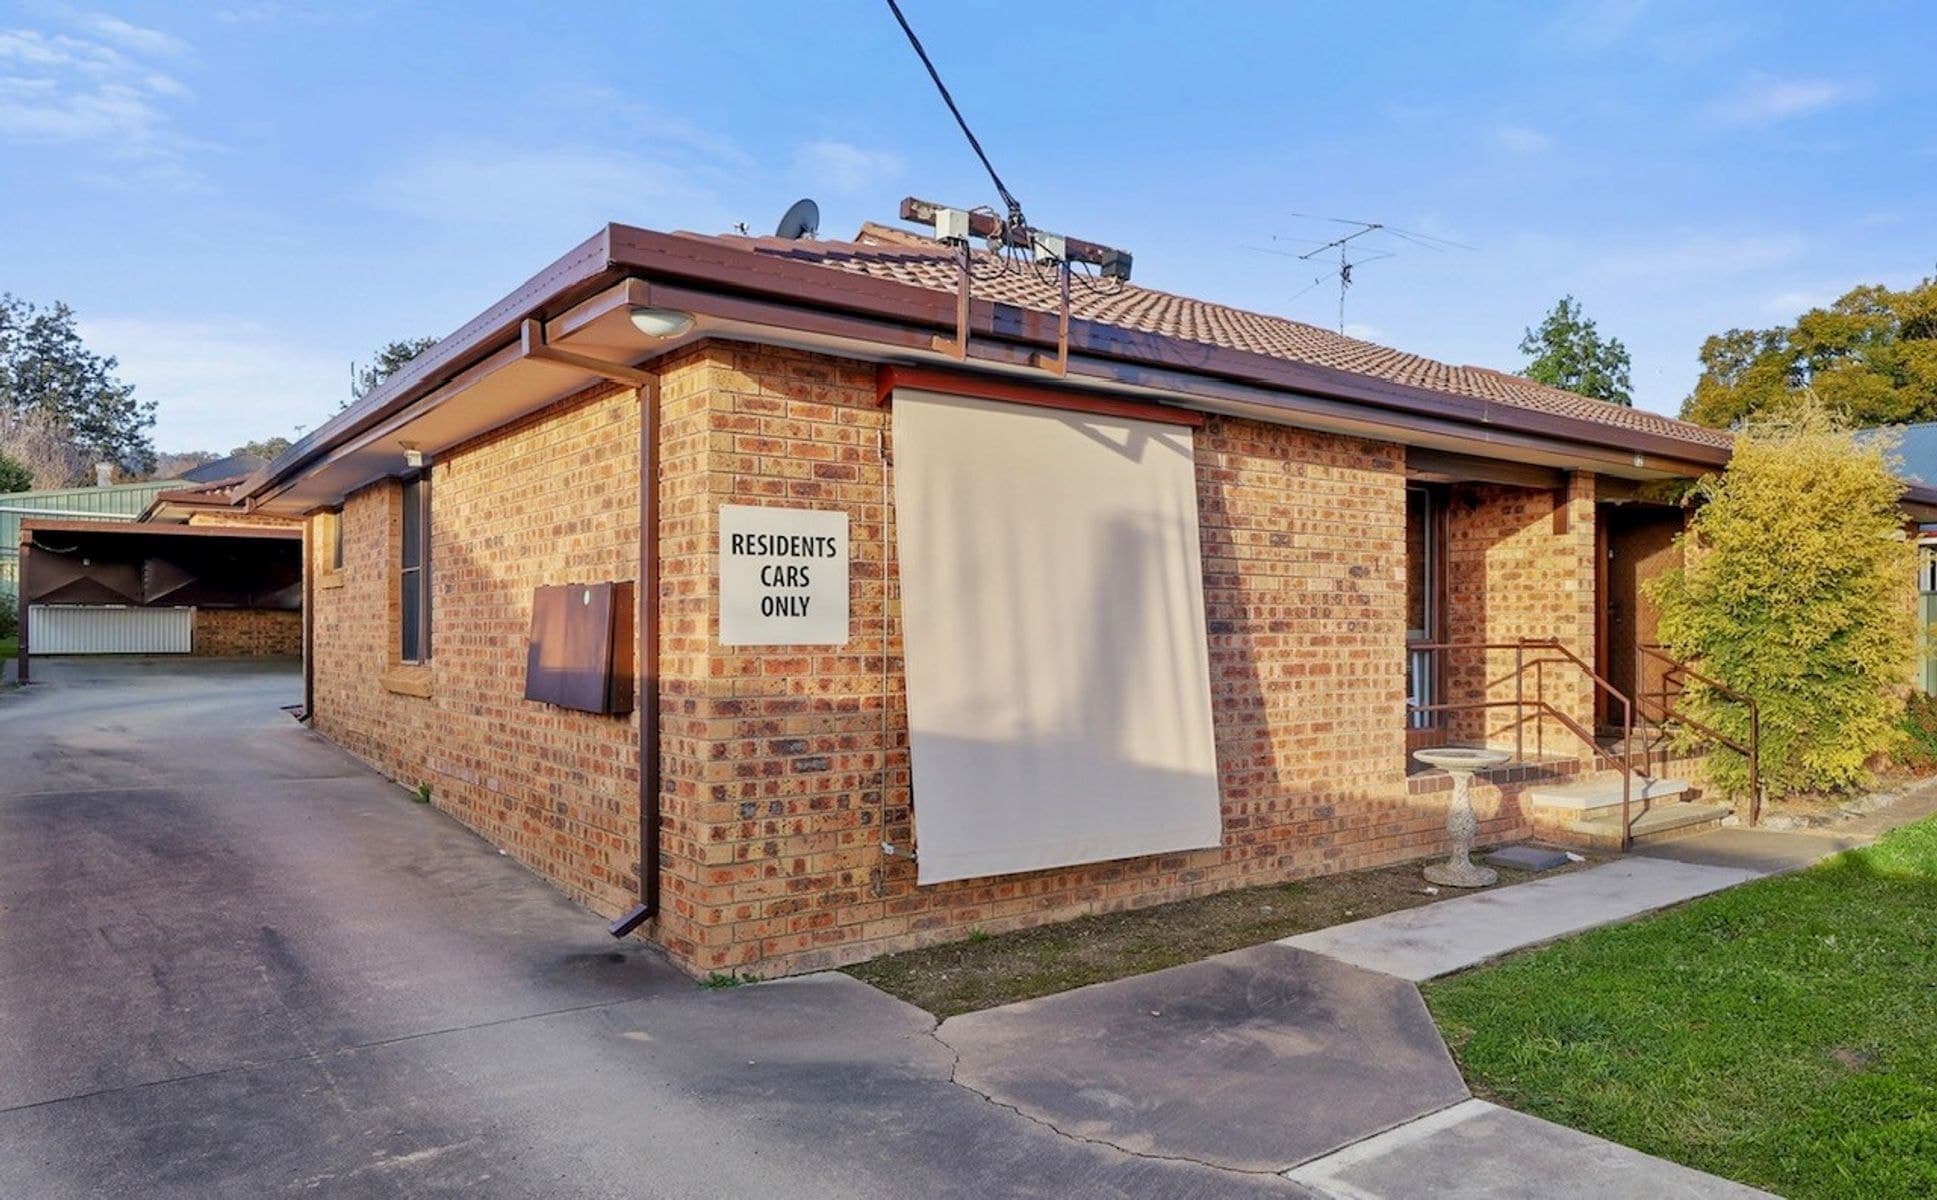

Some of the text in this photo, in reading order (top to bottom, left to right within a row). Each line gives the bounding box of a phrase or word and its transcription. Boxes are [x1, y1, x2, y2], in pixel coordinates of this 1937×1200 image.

[731, 533, 837, 558] RESIDENTS
[760, 565, 810, 588] CARS
[761, 595, 811, 618] ONLY
